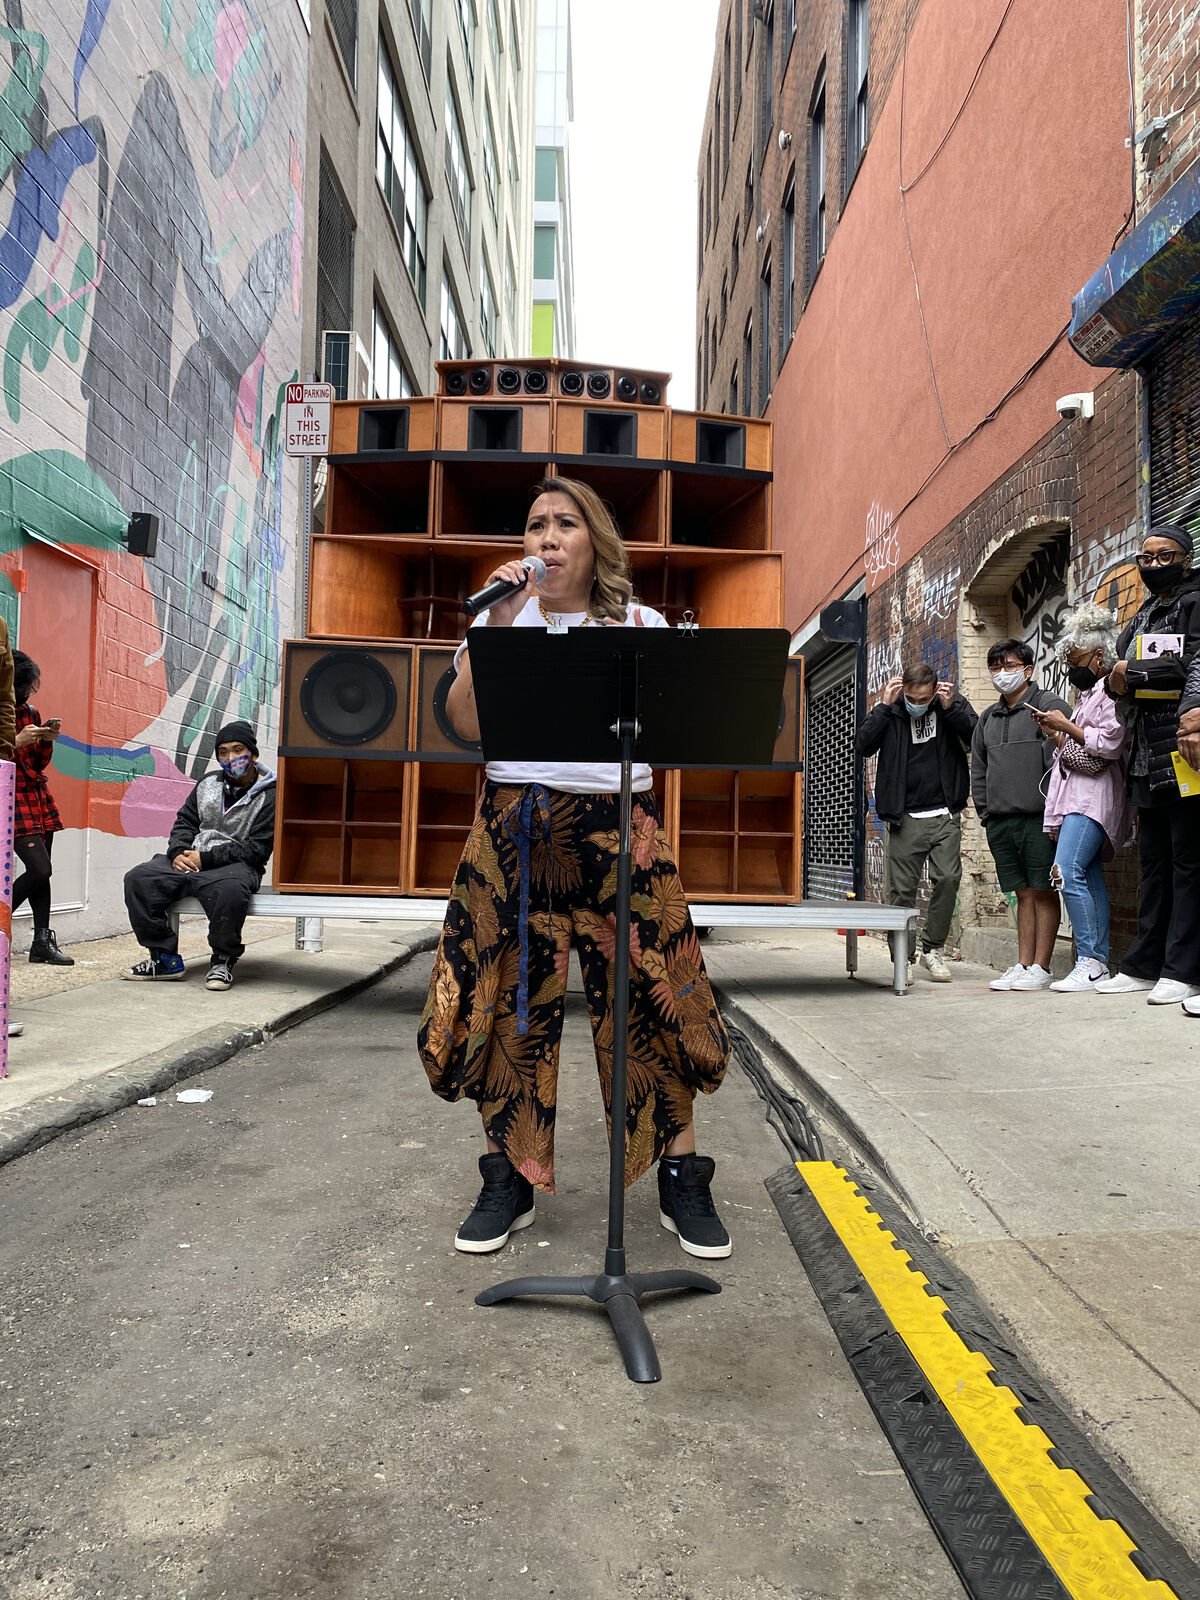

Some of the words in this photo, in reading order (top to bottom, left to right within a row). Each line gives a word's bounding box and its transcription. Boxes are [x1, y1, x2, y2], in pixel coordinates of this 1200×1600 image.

[288, 386, 303, 402] NO
[304, 389, 330, 399] PARKING
[304, 407, 313, 417] IN
[297, 420, 320, 431] THIS
[289, 434, 327, 446] STREET
